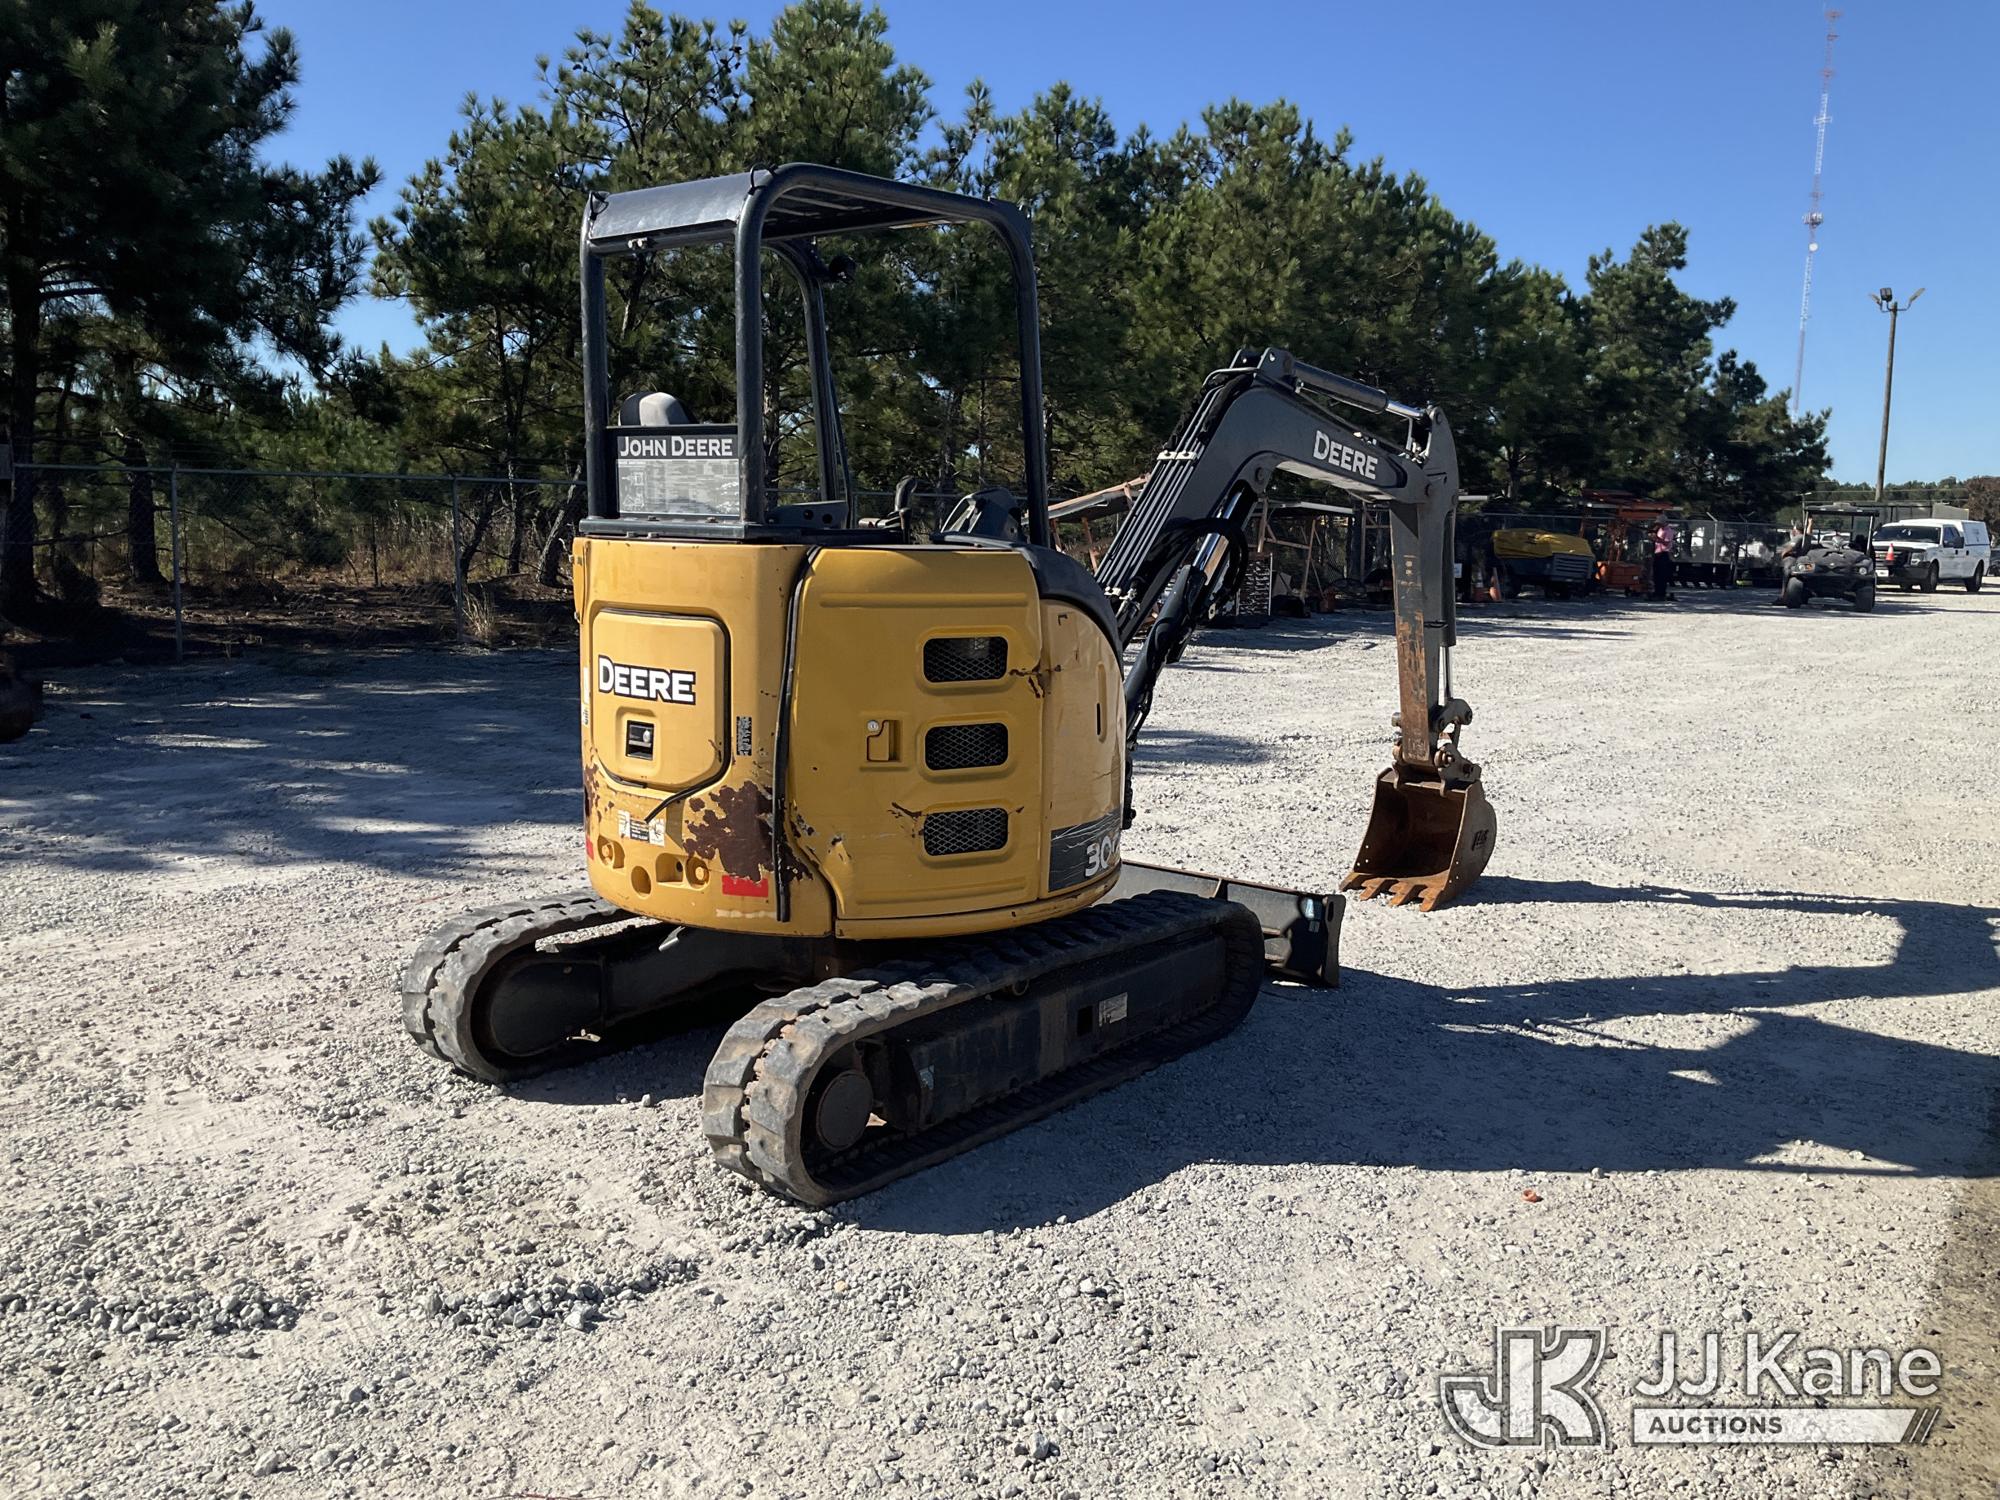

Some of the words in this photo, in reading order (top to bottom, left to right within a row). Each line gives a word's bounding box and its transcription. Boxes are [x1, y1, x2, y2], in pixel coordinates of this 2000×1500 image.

[620, 436, 667, 456] JOHN
[672, 436, 733, 456] DEERE
[1314, 430, 1378, 480] DEERE
[598, 655, 696, 705] DEERE
